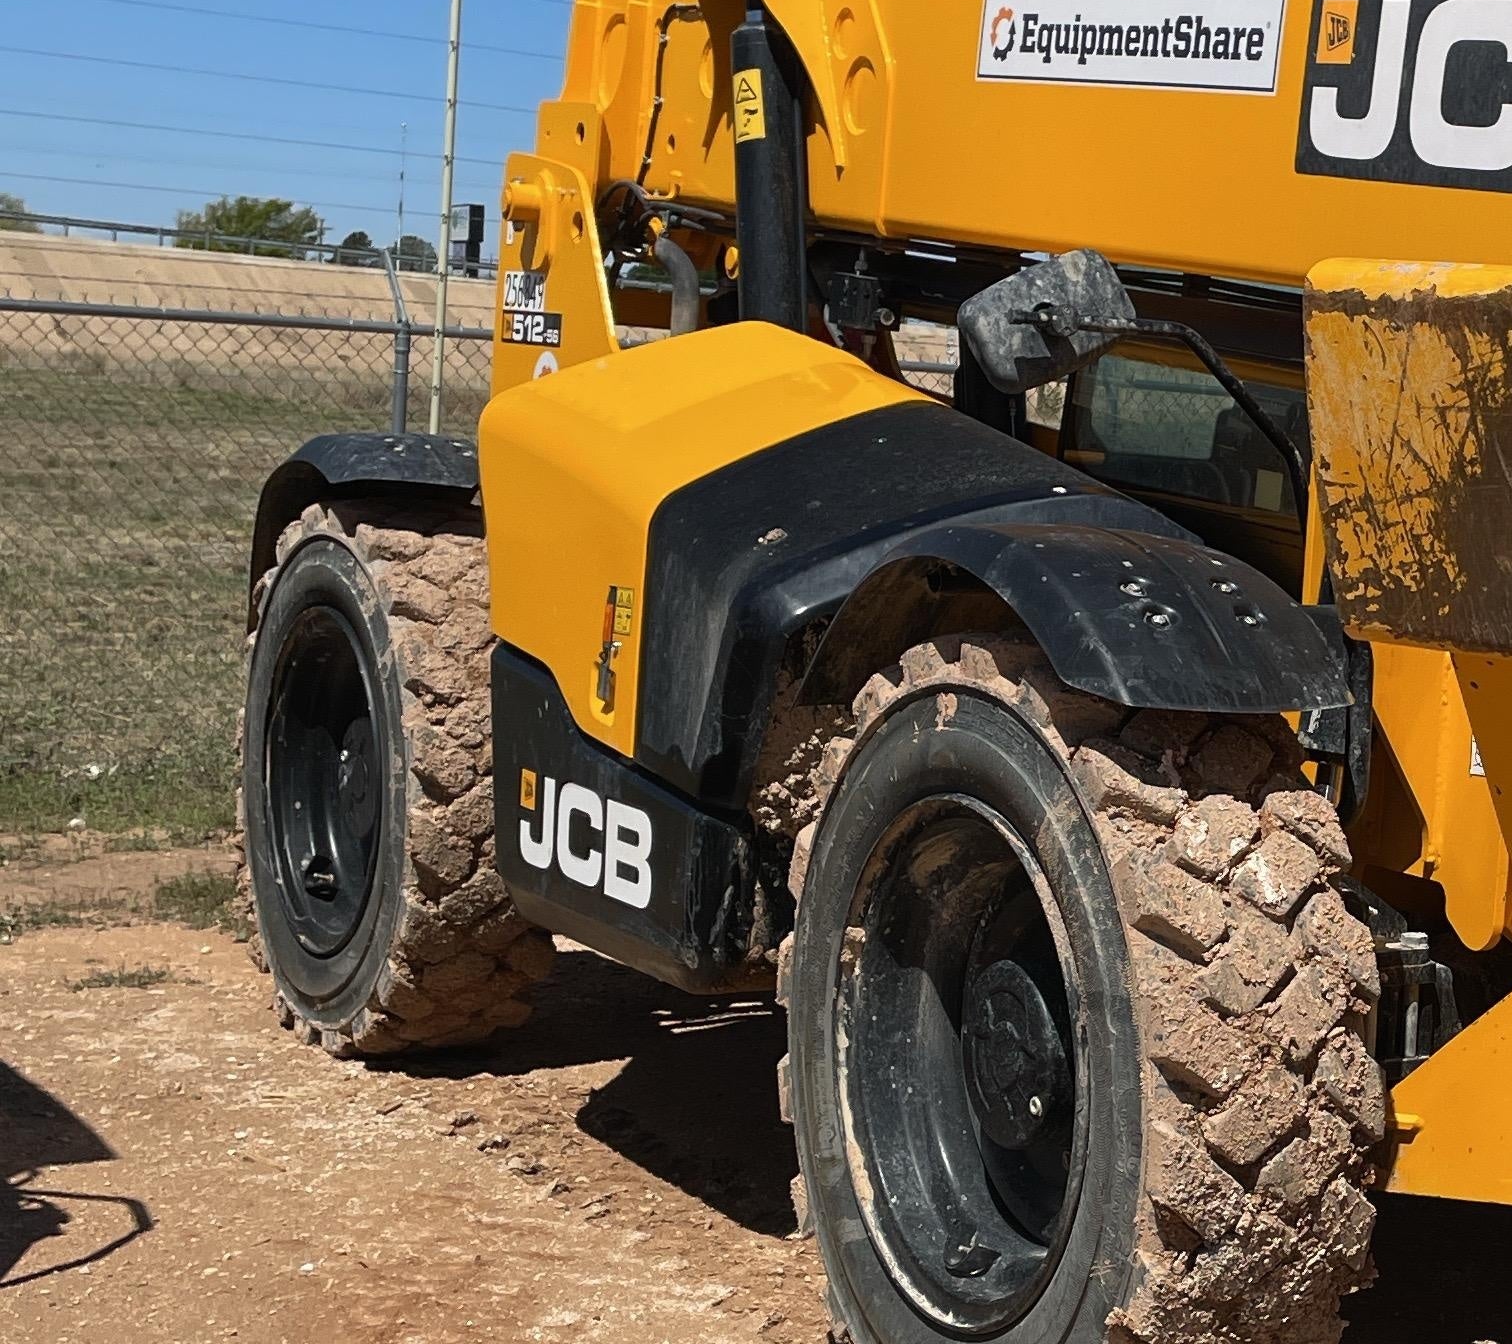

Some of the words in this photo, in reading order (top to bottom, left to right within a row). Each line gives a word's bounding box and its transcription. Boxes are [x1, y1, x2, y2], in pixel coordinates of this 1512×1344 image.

[1019, 13, 1264, 65] EquipmentShare
[1328, 16, 1350, 47] JCB
[519, 776, 653, 910] JCB
